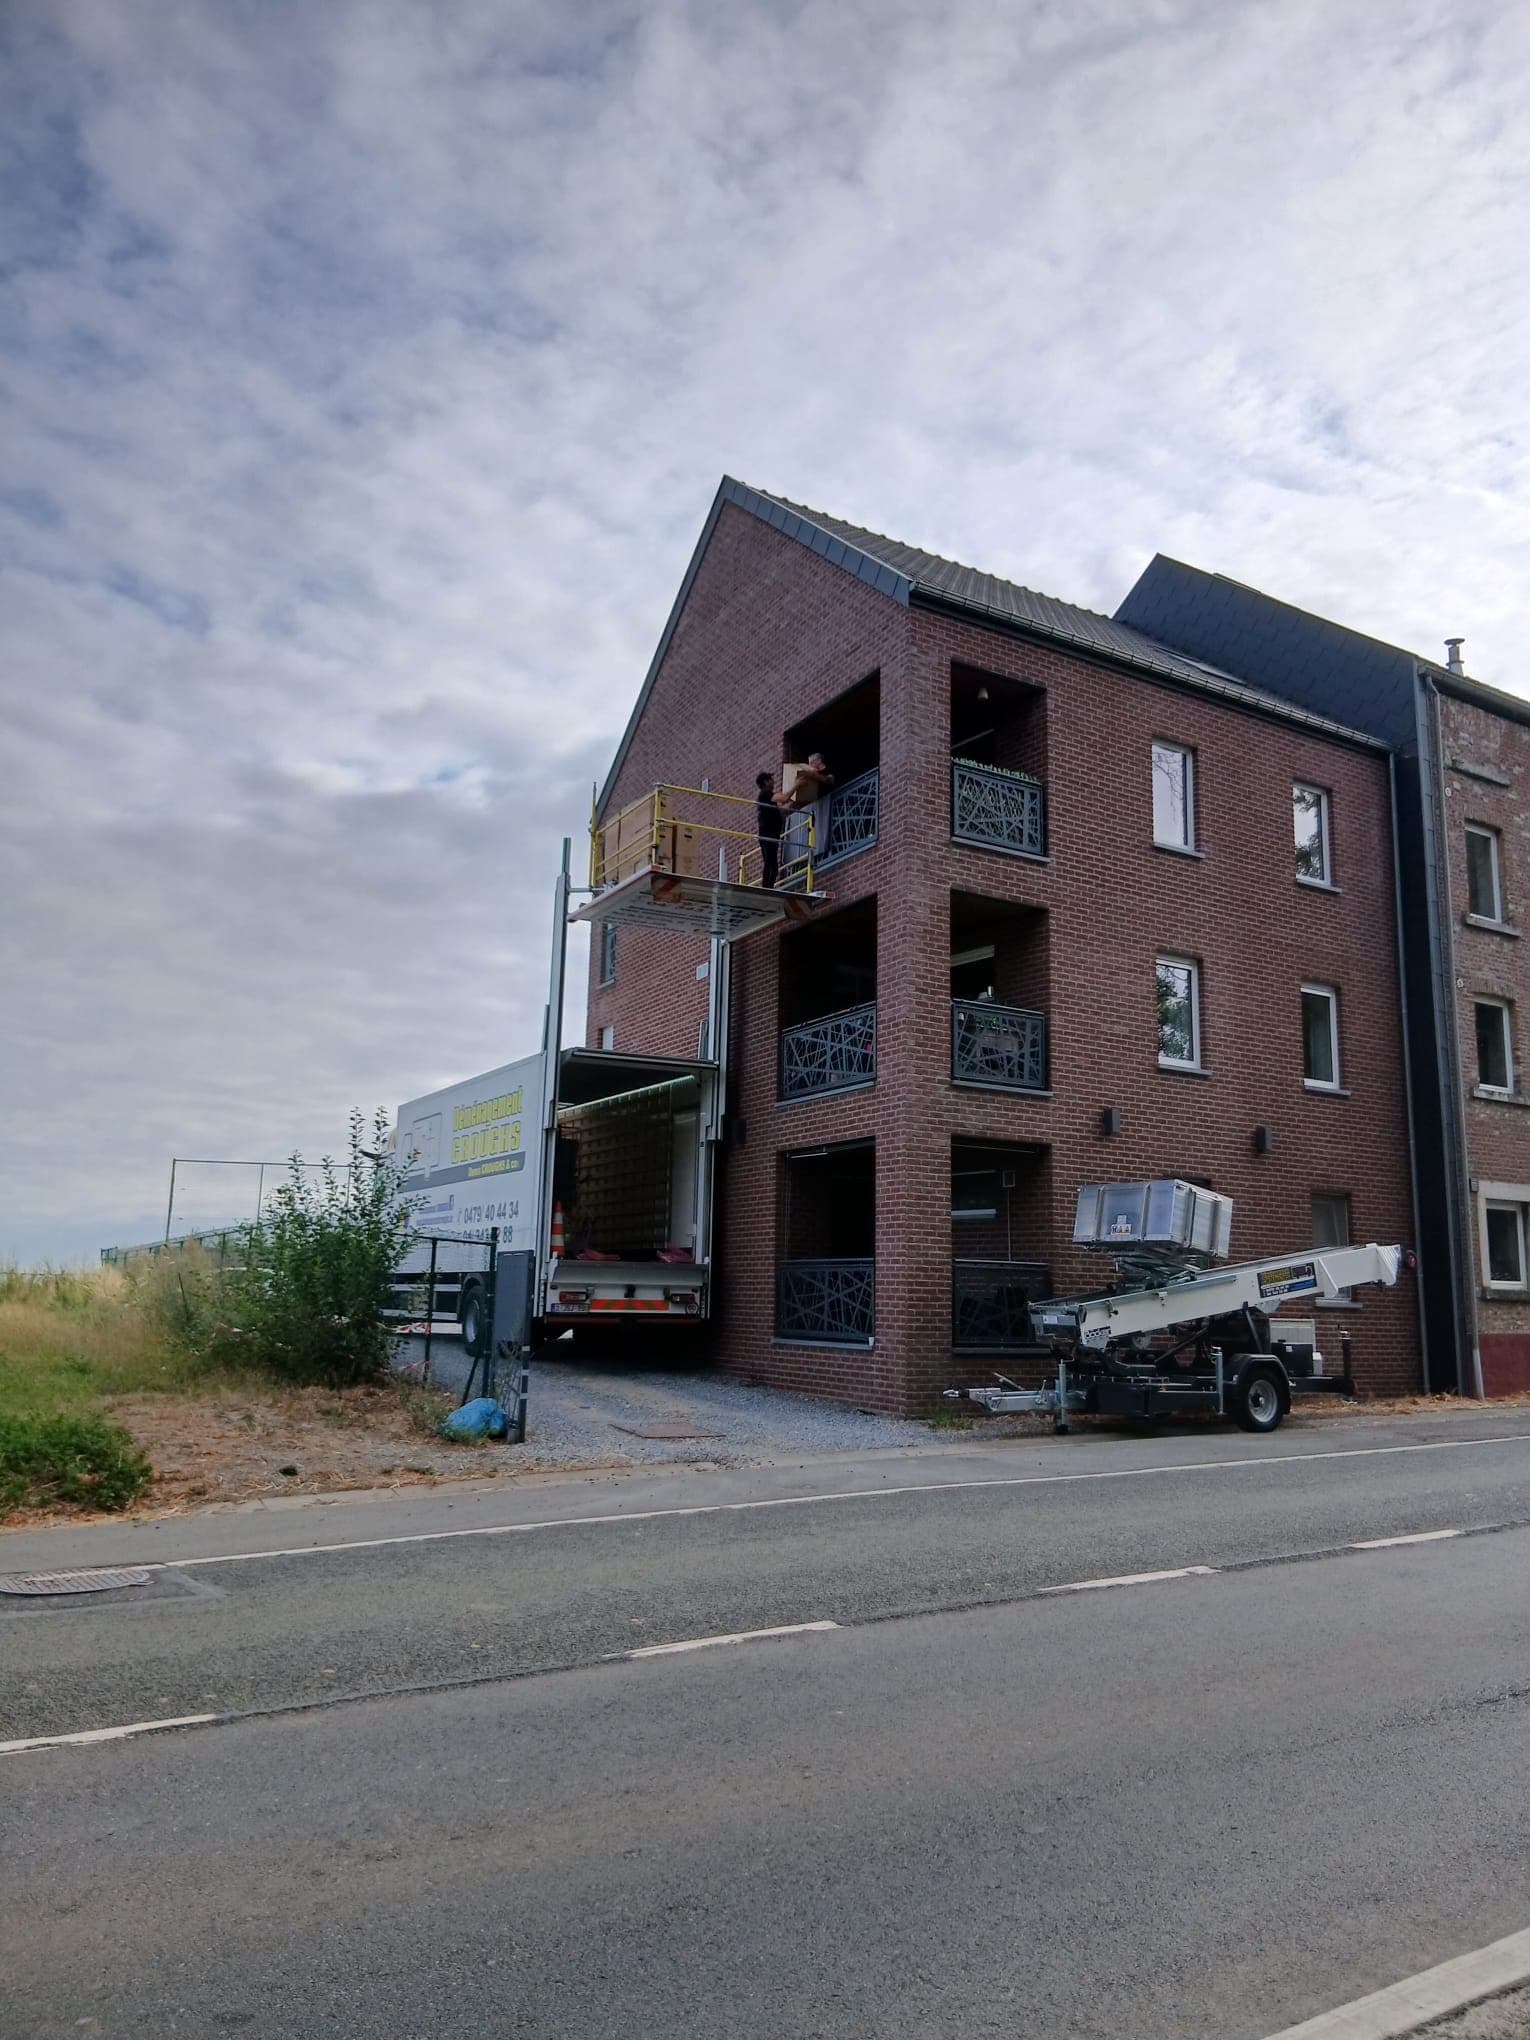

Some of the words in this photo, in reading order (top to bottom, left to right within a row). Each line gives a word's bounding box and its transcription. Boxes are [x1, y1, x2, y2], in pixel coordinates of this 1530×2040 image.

[497, 1202, 506, 1219] 44
[508, 1200, 519, 1219] 34
[502, 1225, 513, 1243] 88
